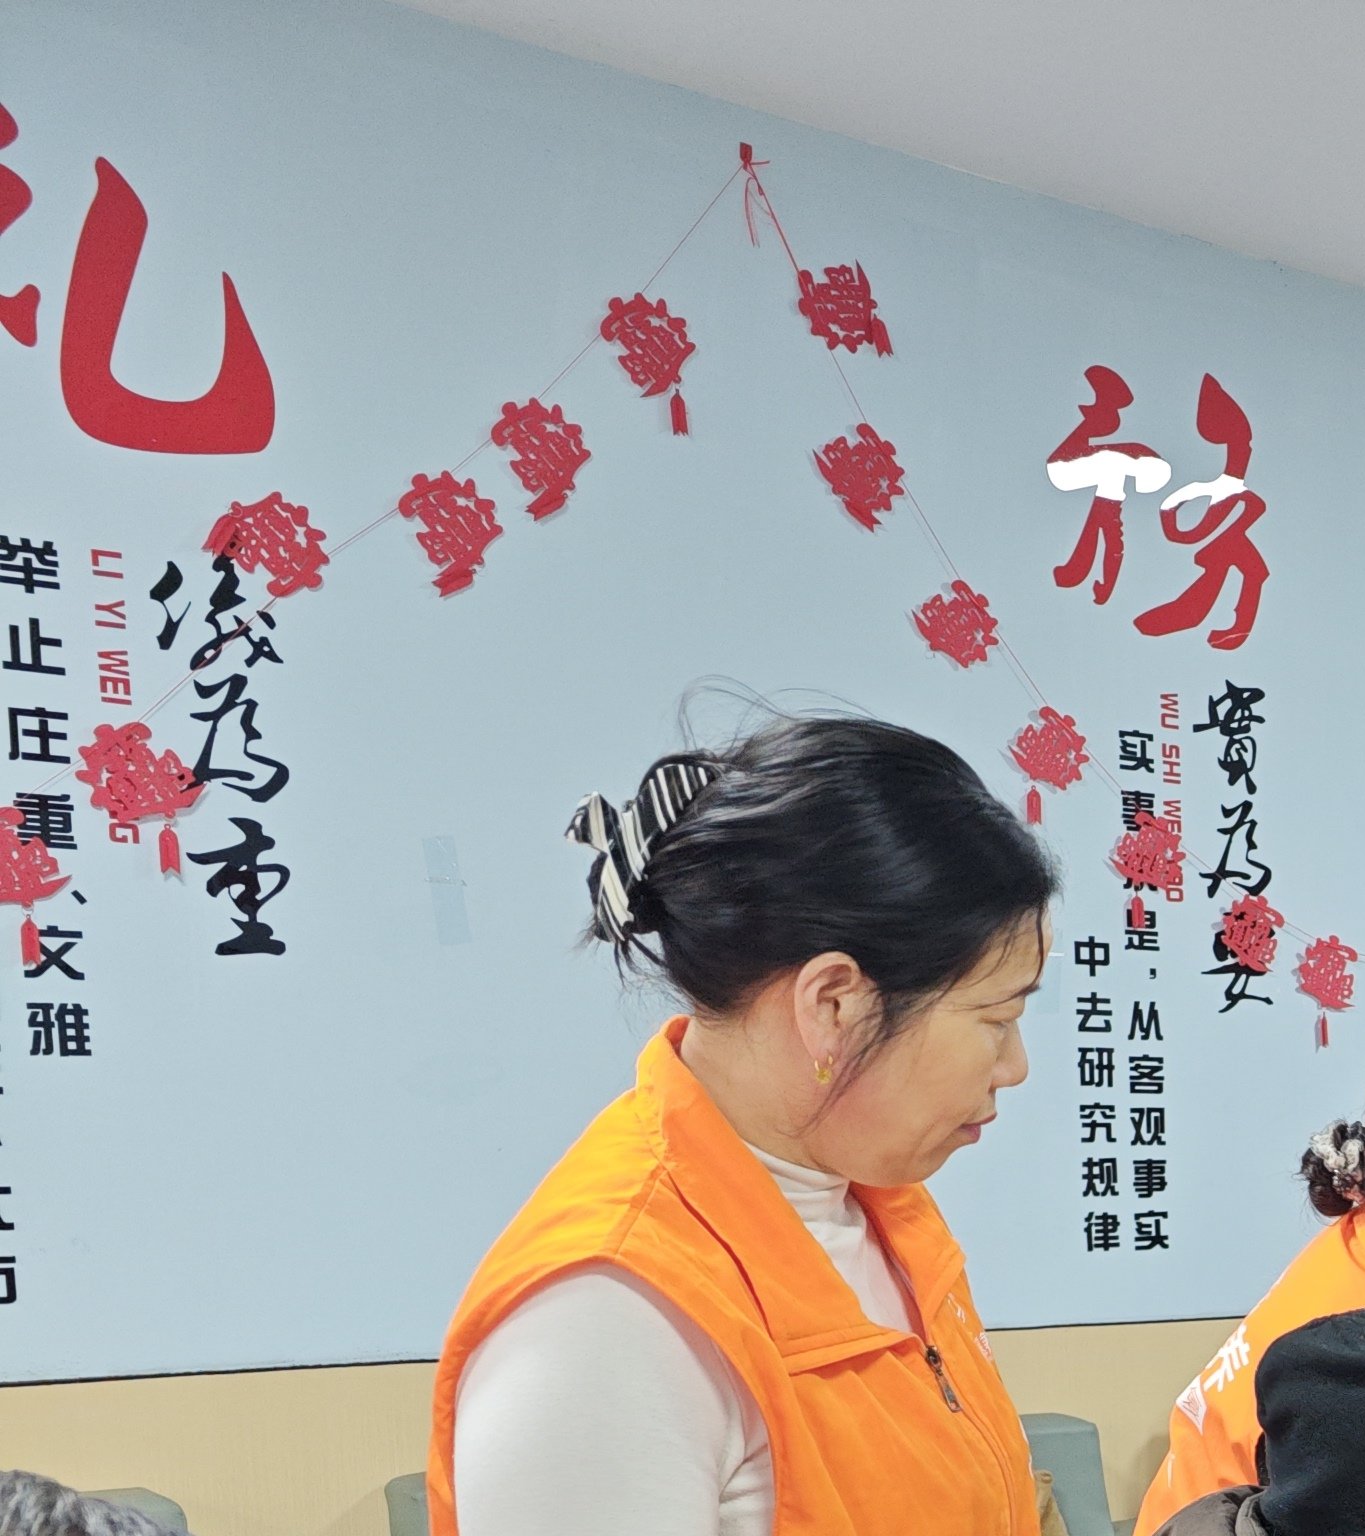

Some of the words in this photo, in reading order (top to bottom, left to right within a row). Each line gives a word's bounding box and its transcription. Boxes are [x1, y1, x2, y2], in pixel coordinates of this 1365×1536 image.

[91, 549, 123, 580] LI
[95, 600, 127, 629] YI
[97, 650, 132, 706] WEI
[1160, 693, 1180, 730] WU
[1161, 743, 1182, 784] SHI
[1074, 935, 1122, 1252] 中去研究规律
